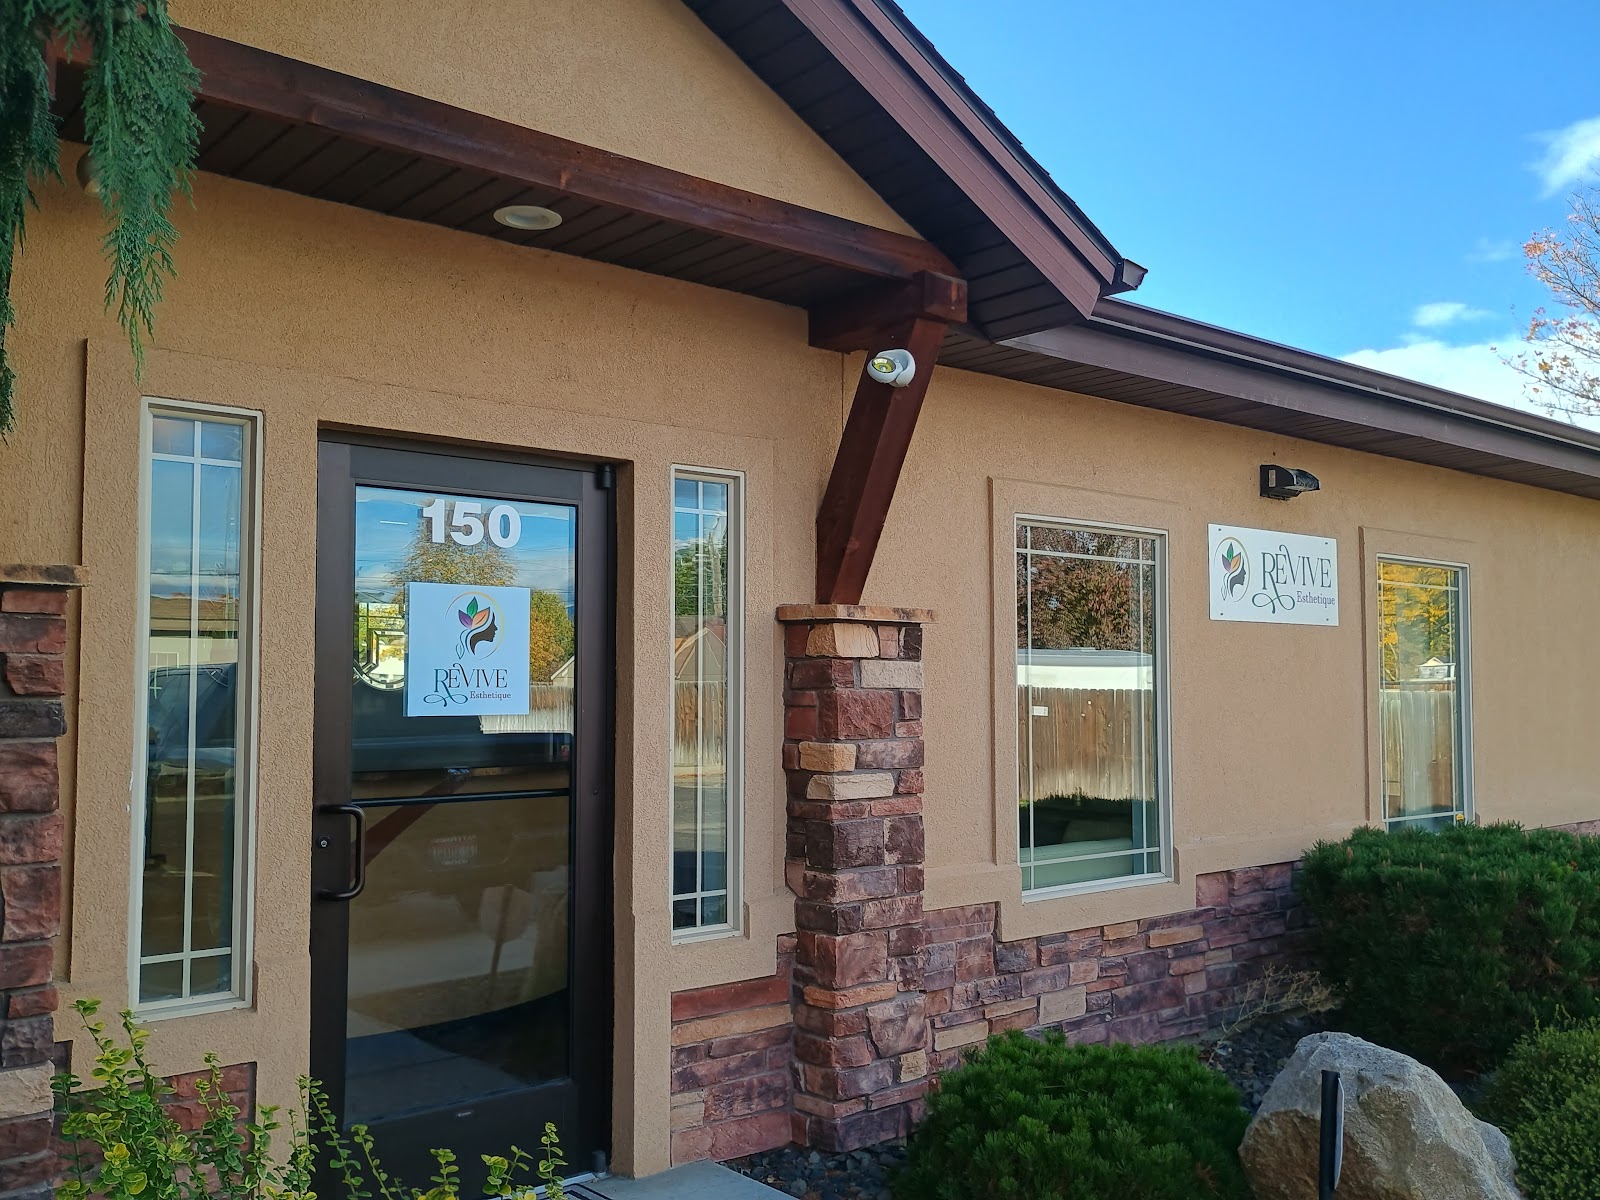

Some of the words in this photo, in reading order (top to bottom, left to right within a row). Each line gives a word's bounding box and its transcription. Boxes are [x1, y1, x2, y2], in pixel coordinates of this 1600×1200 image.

[423, 499, 522, 548] 150
[1252, 545, 1331, 613] REVIVE
[1296, 590, 1336, 608] Esthetique
[424, 663, 507, 706] REVIVE
[470, 690, 511, 702] Esthetique
